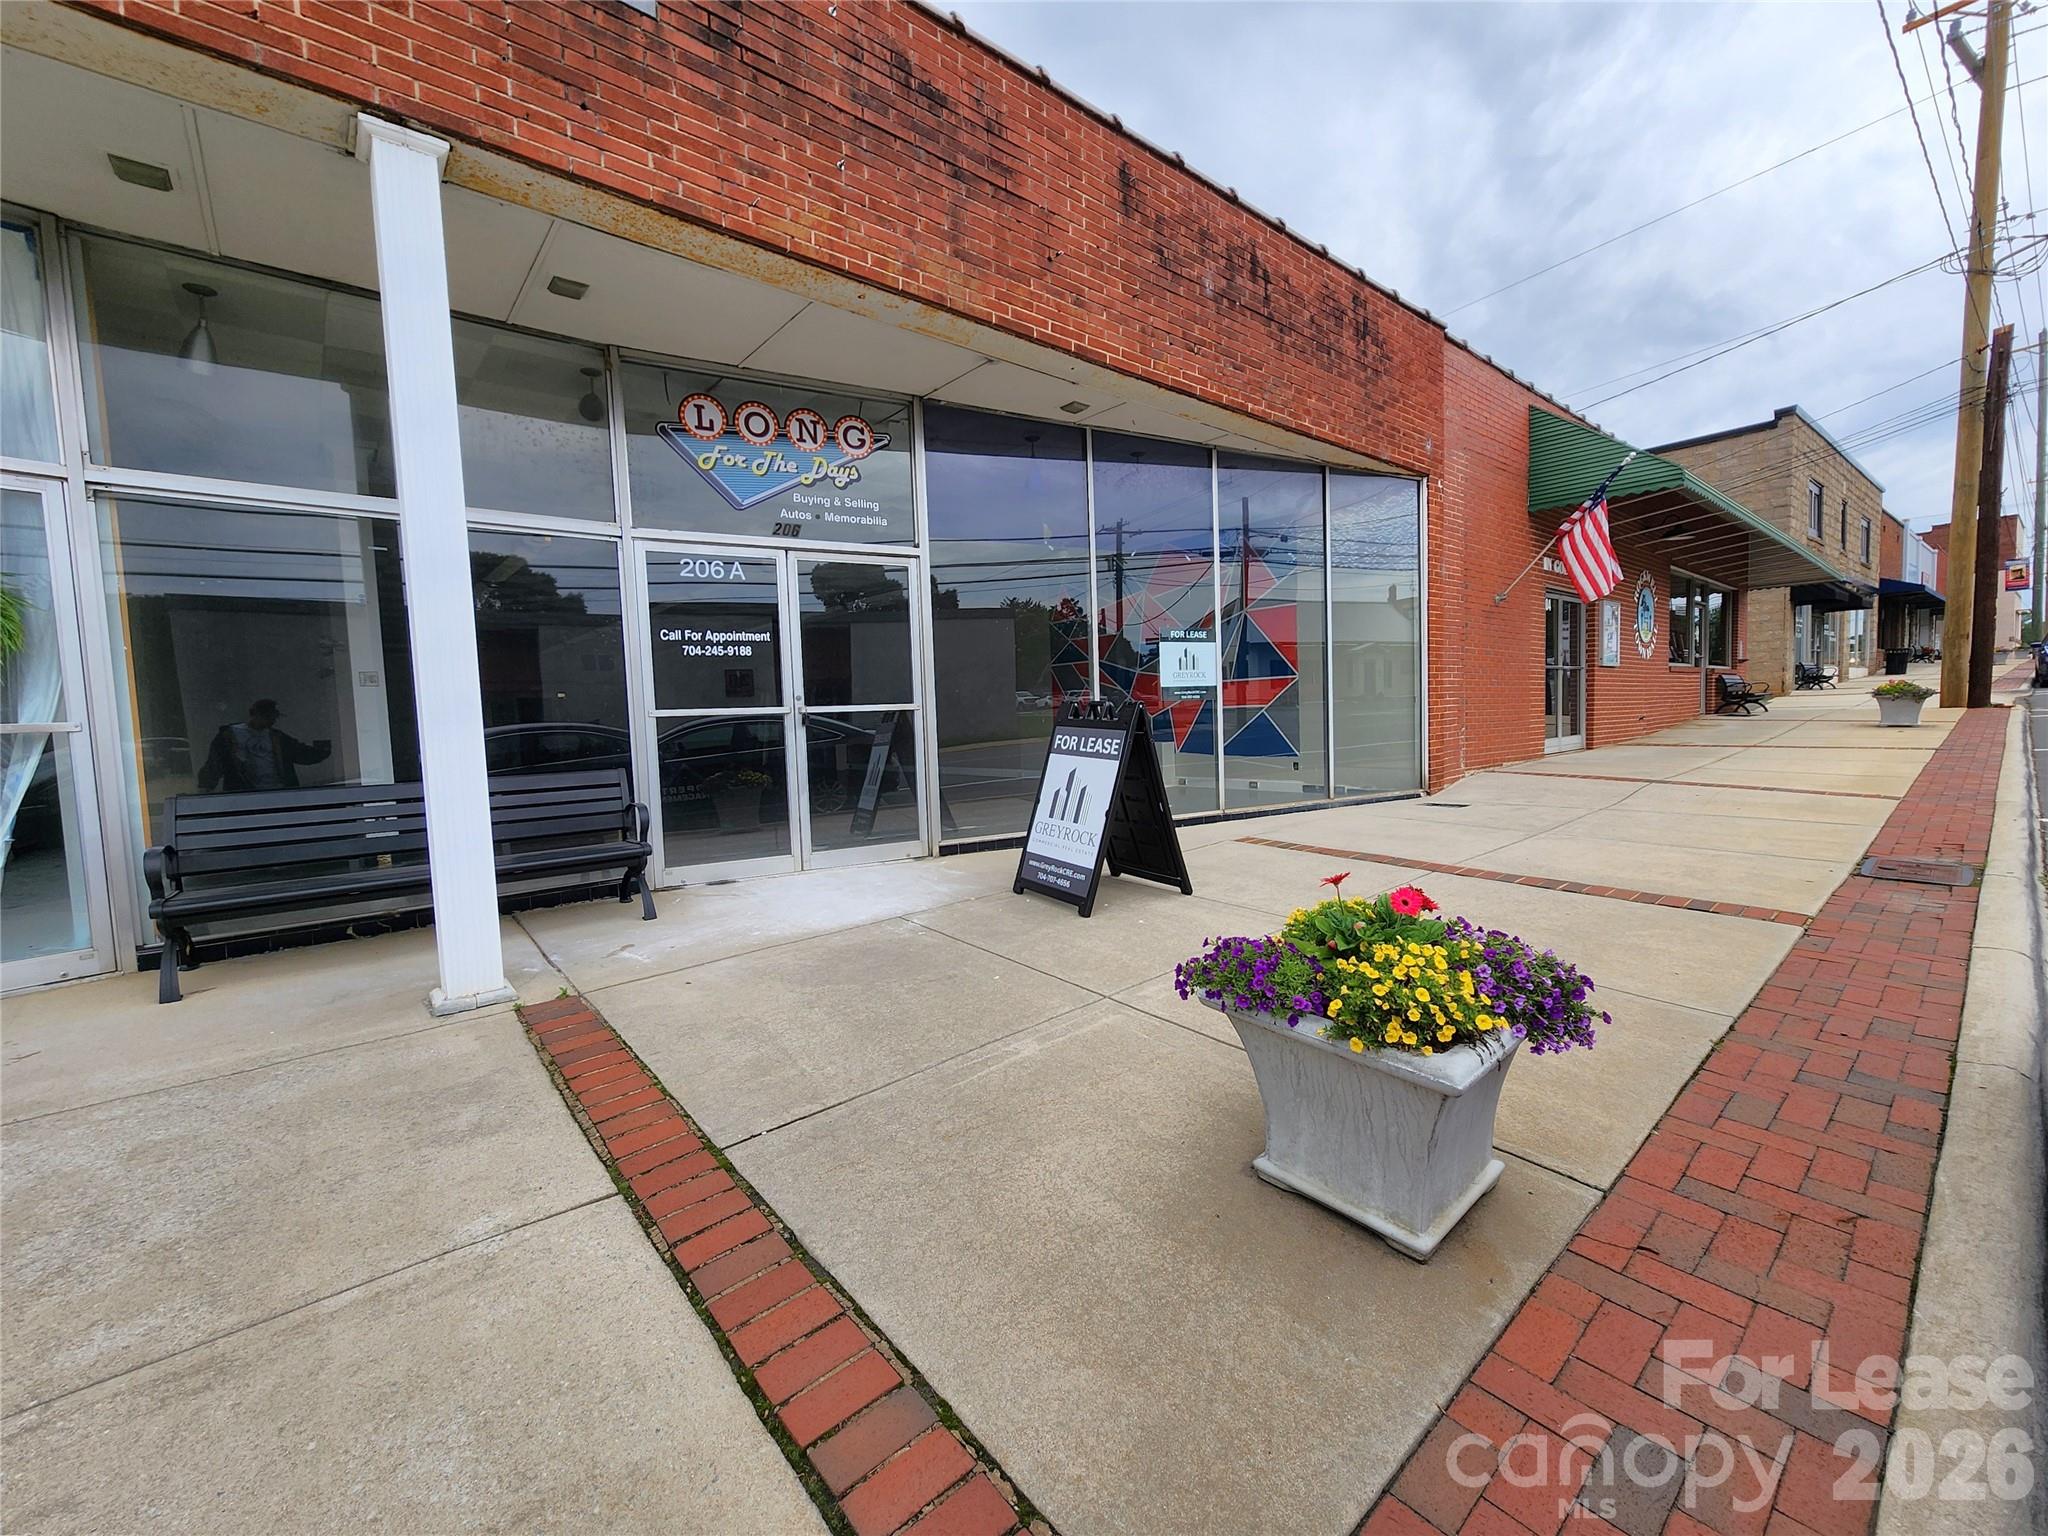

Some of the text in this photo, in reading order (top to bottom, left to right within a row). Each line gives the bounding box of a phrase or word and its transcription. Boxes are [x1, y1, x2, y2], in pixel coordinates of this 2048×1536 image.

[691, 401, 868, 451] LONG
[697, 444, 861, 489] For The Days
[793, 492, 880, 512] Buying & Selling
[780, 508, 888, 527] Autos Memorabilia
[772, 522, 802, 537] 206
[679, 558, 746, 581] 206 A
[1553, 559, 1569, 576] GO
[660, 629, 771, 644] Call For Appointment
[1170, 630, 1207, 639] FOR LEASE
[682, 645, 753, 656] 704-245-9188
[1054, 735, 1121, 755] FOR LEASE
[1034, 820, 1098, 848] GREYROCK
